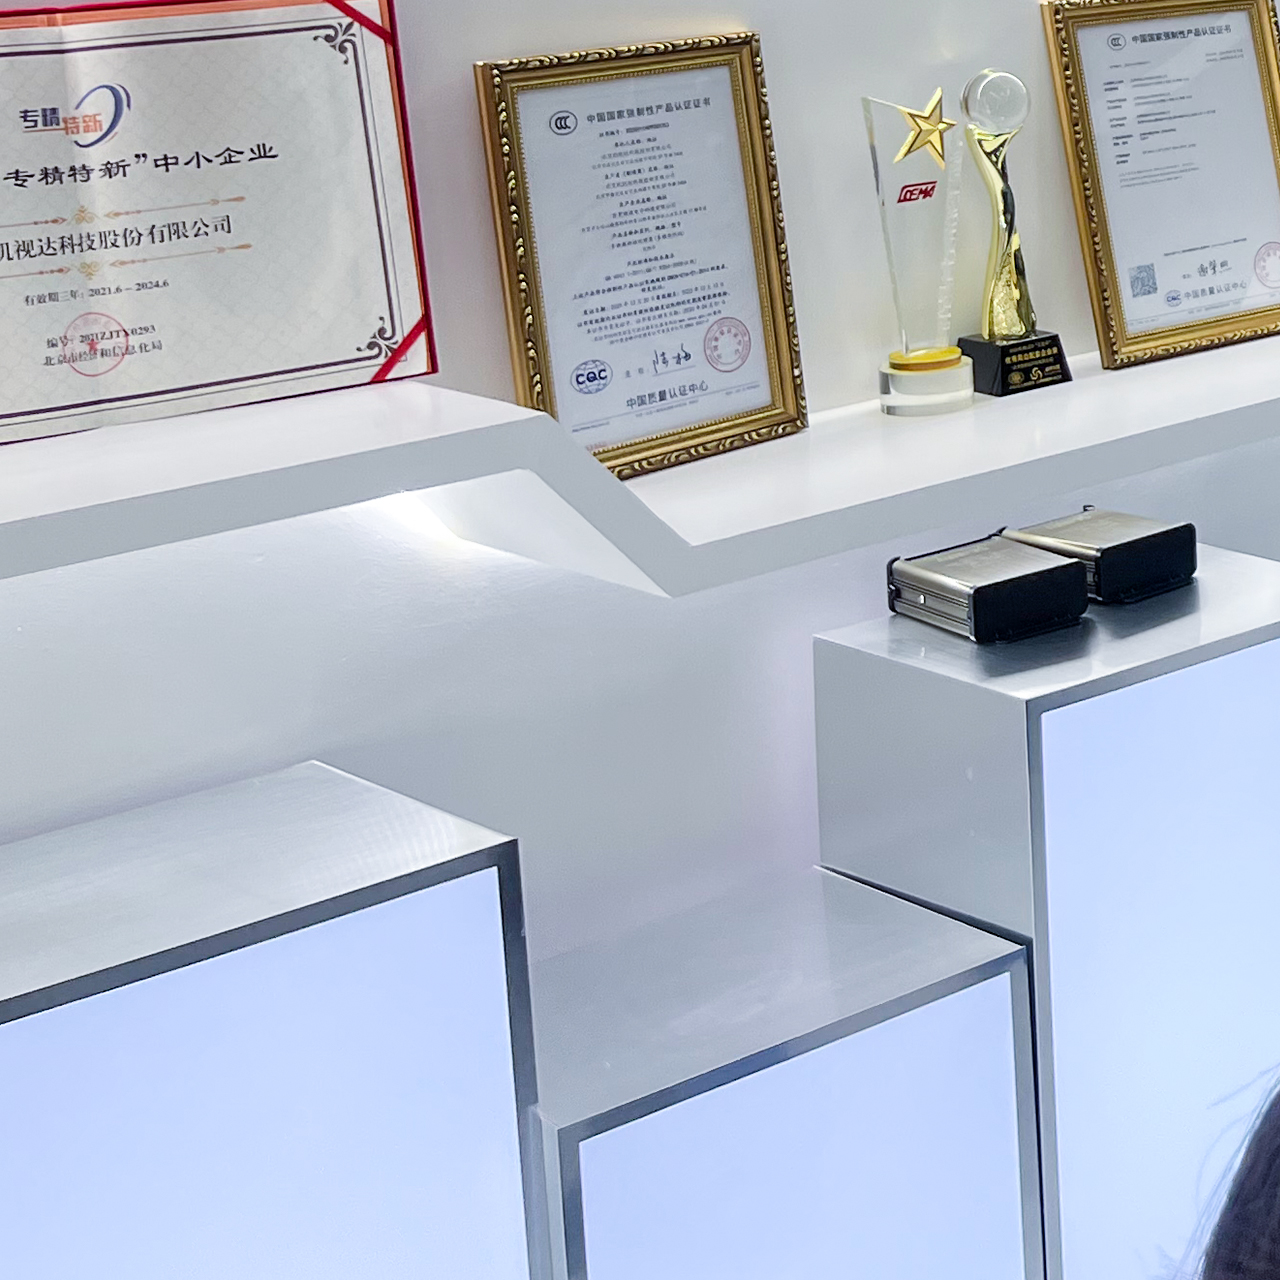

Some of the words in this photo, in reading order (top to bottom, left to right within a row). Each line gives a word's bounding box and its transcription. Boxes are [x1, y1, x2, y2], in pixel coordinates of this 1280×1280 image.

[19, 107, 61, 130] 专精
[586, 97, 711, 123] 中国国家强制性产品认证证书
[62, 113, 104, 136] 特新
[88, 285, 122, 298] 2021.6
[135, 279, 169, 292] 2024.6
[1184, 280, 1247, 300] 中国质量认证中心
[575, 368, 608, 385] CQC
[626, 380, 709, 410] 中国质量认证中心
